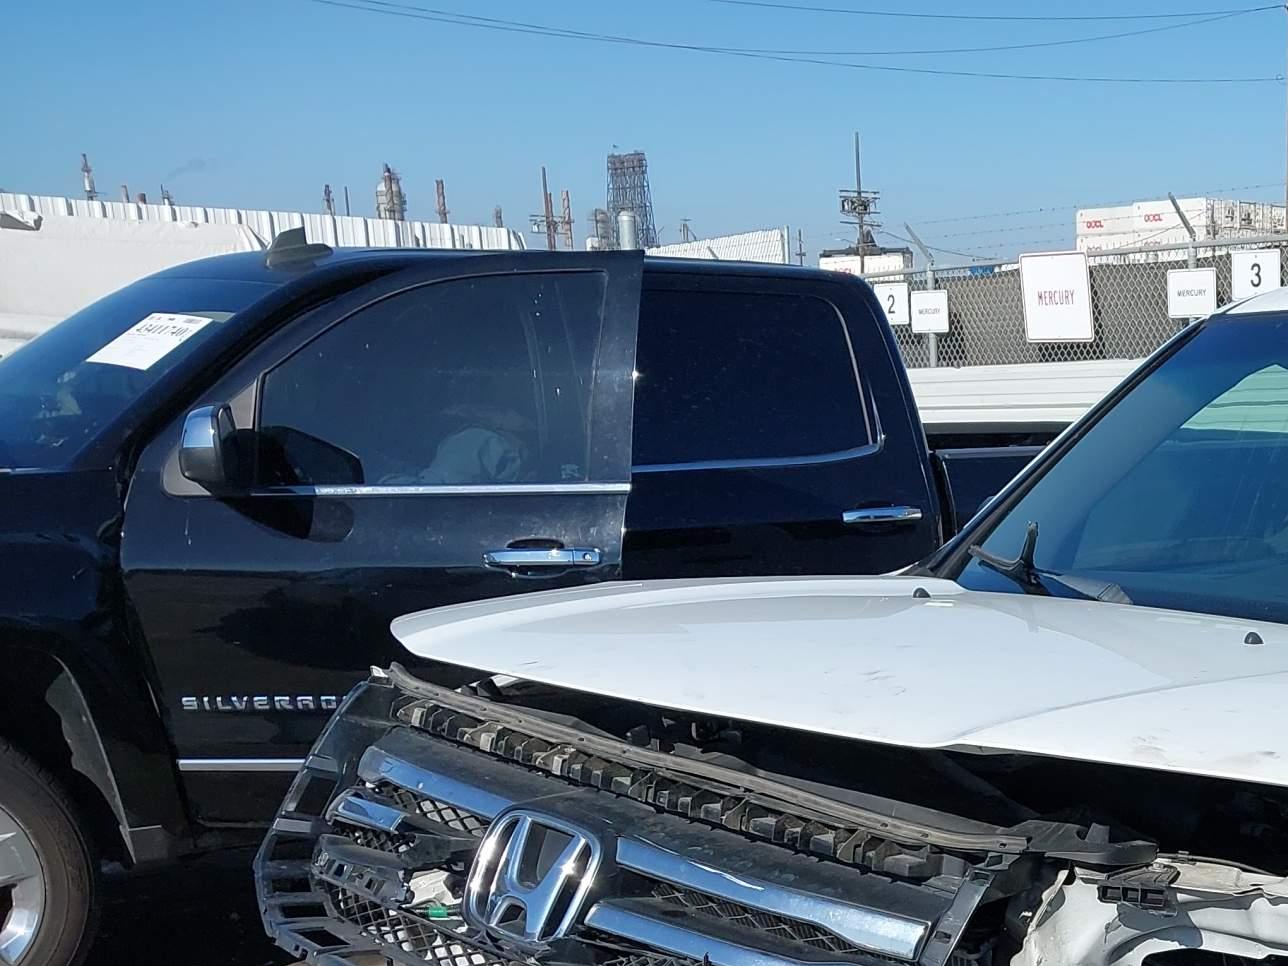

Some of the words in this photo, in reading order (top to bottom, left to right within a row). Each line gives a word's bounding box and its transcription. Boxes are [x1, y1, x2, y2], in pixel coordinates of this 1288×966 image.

[1250, 263, 1262, 288] 3
[1037, 289, 1075, 306] MERCURY
[1177, 288, 1207, 297] MERCURY
[887, 294, 896, 314] 2
[181, 696, 347, 710] SILVERAD
